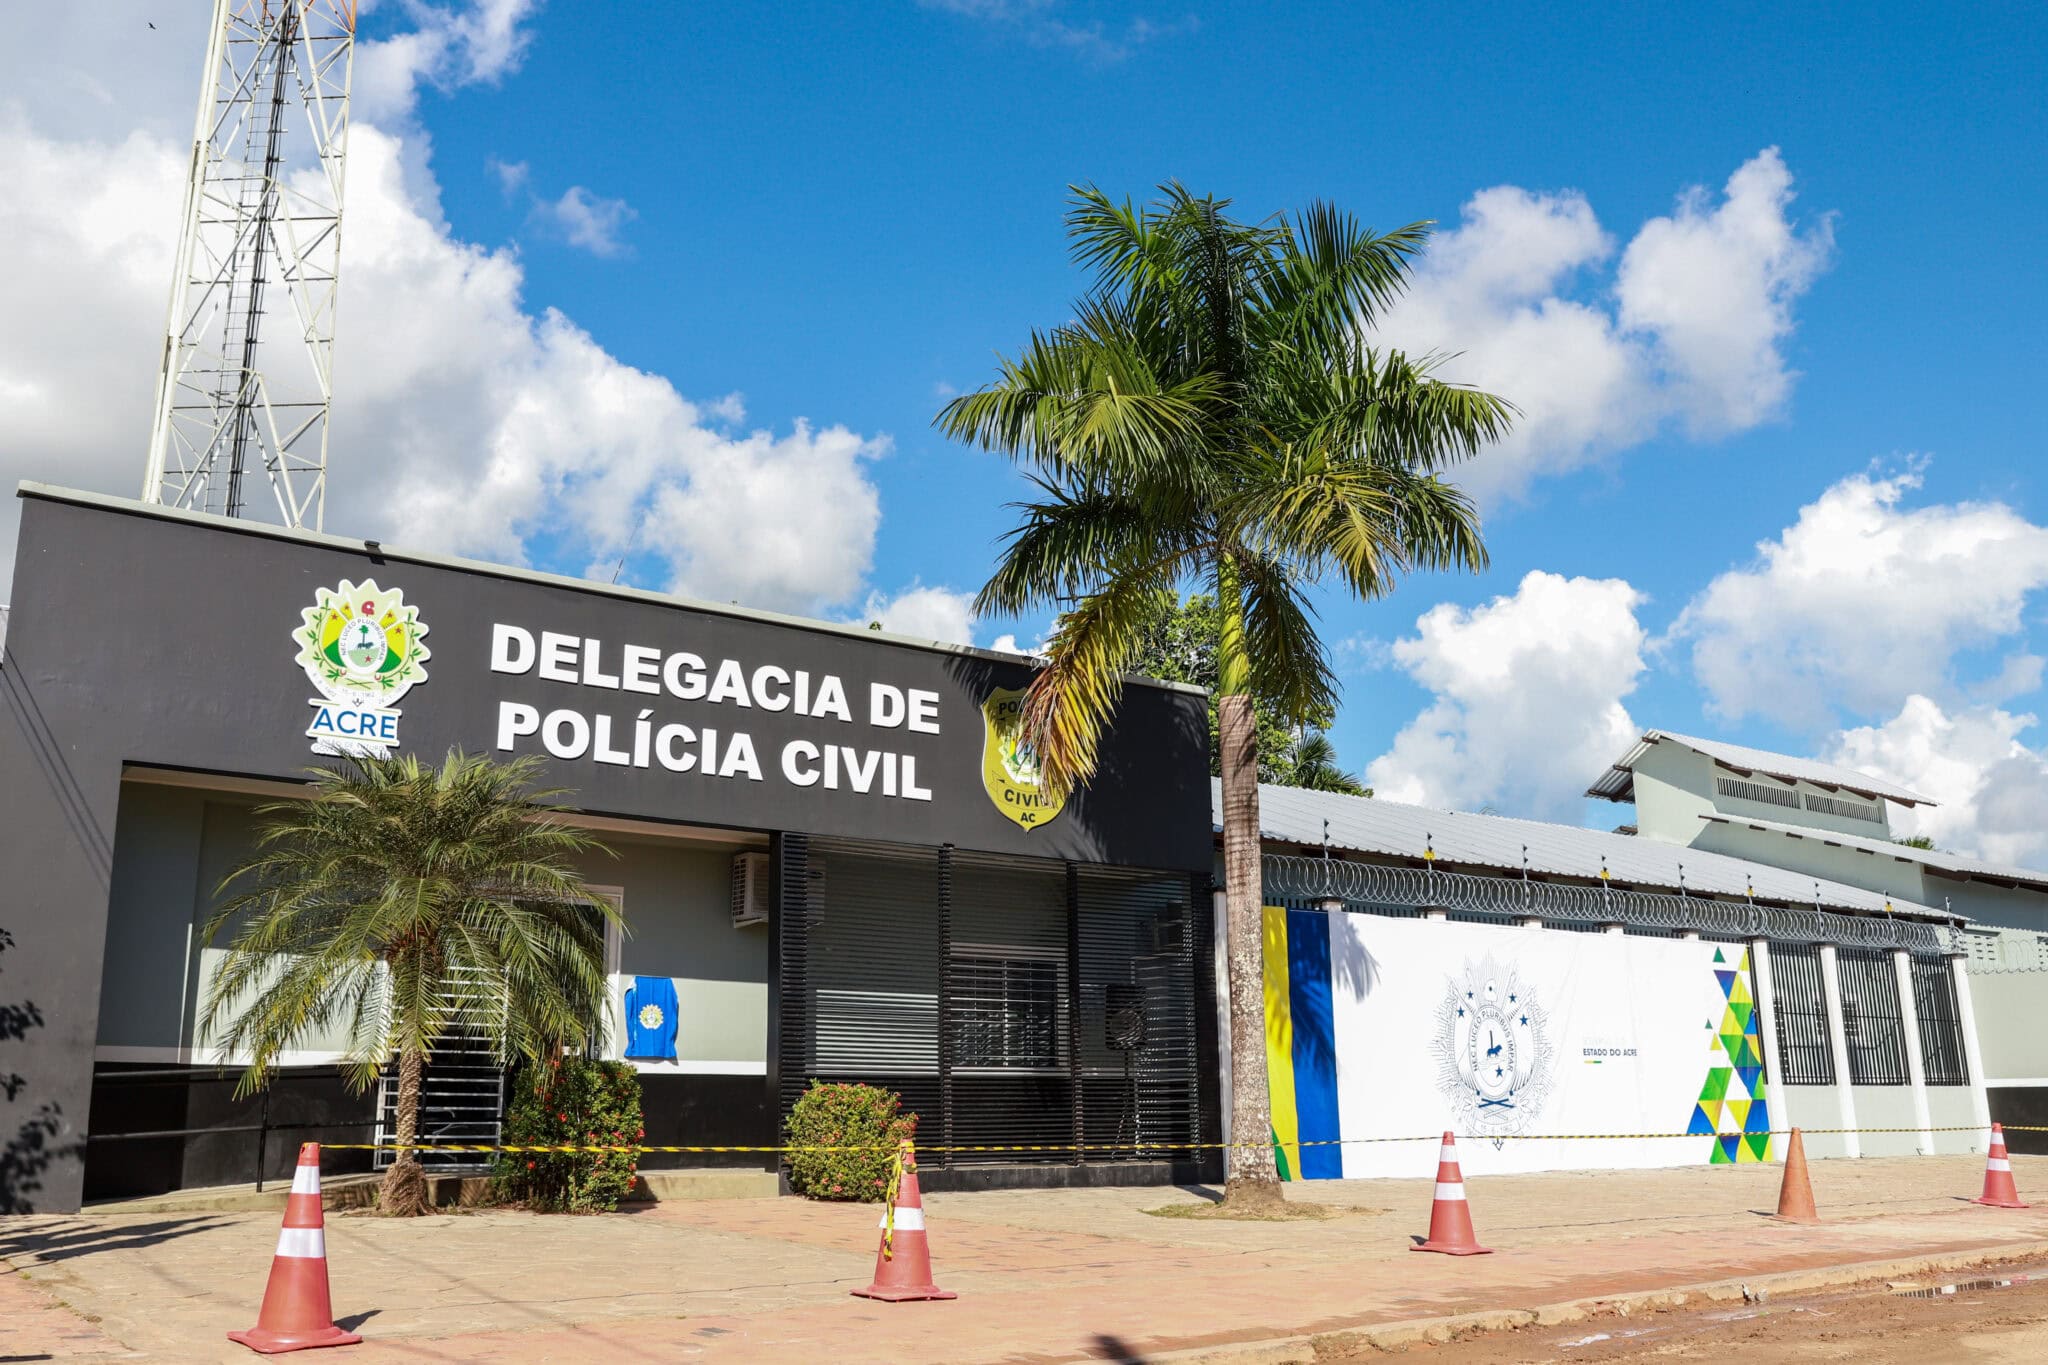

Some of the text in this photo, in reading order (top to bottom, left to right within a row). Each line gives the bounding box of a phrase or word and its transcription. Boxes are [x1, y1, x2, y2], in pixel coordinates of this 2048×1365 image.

[490, 623, 940, 734] DELEGACIA DE
[312, 707, 396, 739] ACRE
[496, 700, 933, 801] POLÍCIA CIVIL
[1020, 812, 1036, 823] AC
[1481, 1010, 1511, 1038] PLURIBUS
[1583, 1048, 1608, 1056] ESTADO
[1609, 1048, 1621, 1057] DO
